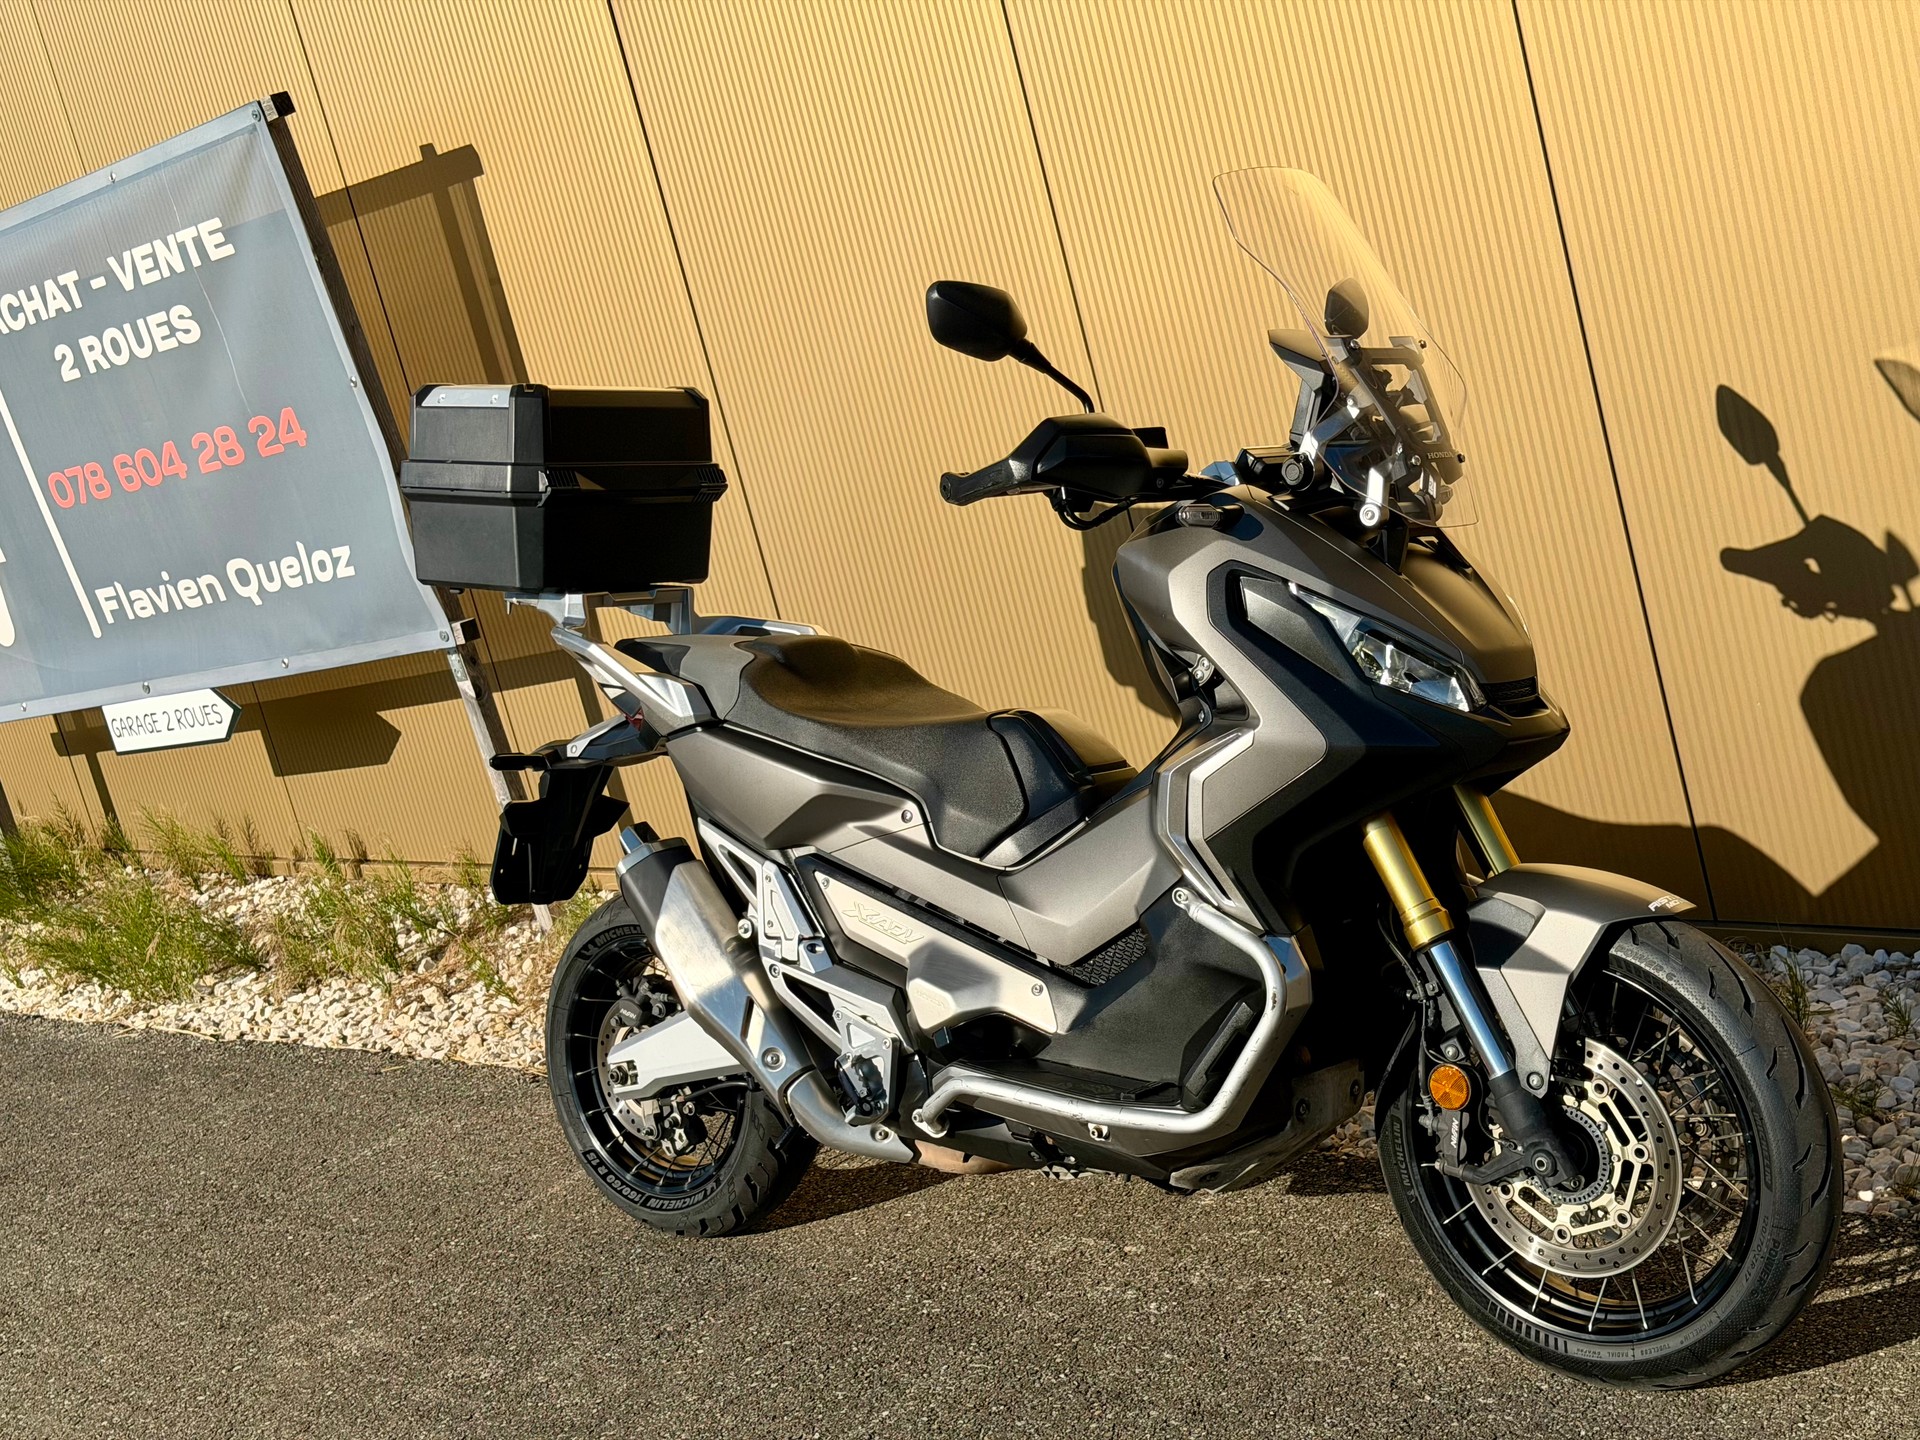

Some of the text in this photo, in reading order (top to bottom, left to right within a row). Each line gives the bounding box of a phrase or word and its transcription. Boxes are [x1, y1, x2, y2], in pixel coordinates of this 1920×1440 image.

[0, 269, 83, 335] CHAT
[106, 216, 236, 292] VENTE
[54, 304, 202, 382] 2 ROUES
[47, 406, 308, 509] 078 604 28 24
[1427, 451, 1455, 460] HONDA
[94, 541, 356, 625] Flavien Queloz
[110, 703, 224, 739] GARAGE 2 ROUES
[595, 926, 642, 947] MICHELI
[585, 1152, 600, 1166] 15
[1393, 1121, 1411, 1187] MICHELIN
[597, 1165, 606, 1176] R
[606, 1173, 643, 1202] 160/60
[647, 1188, 705, 1210] MICHELIN
